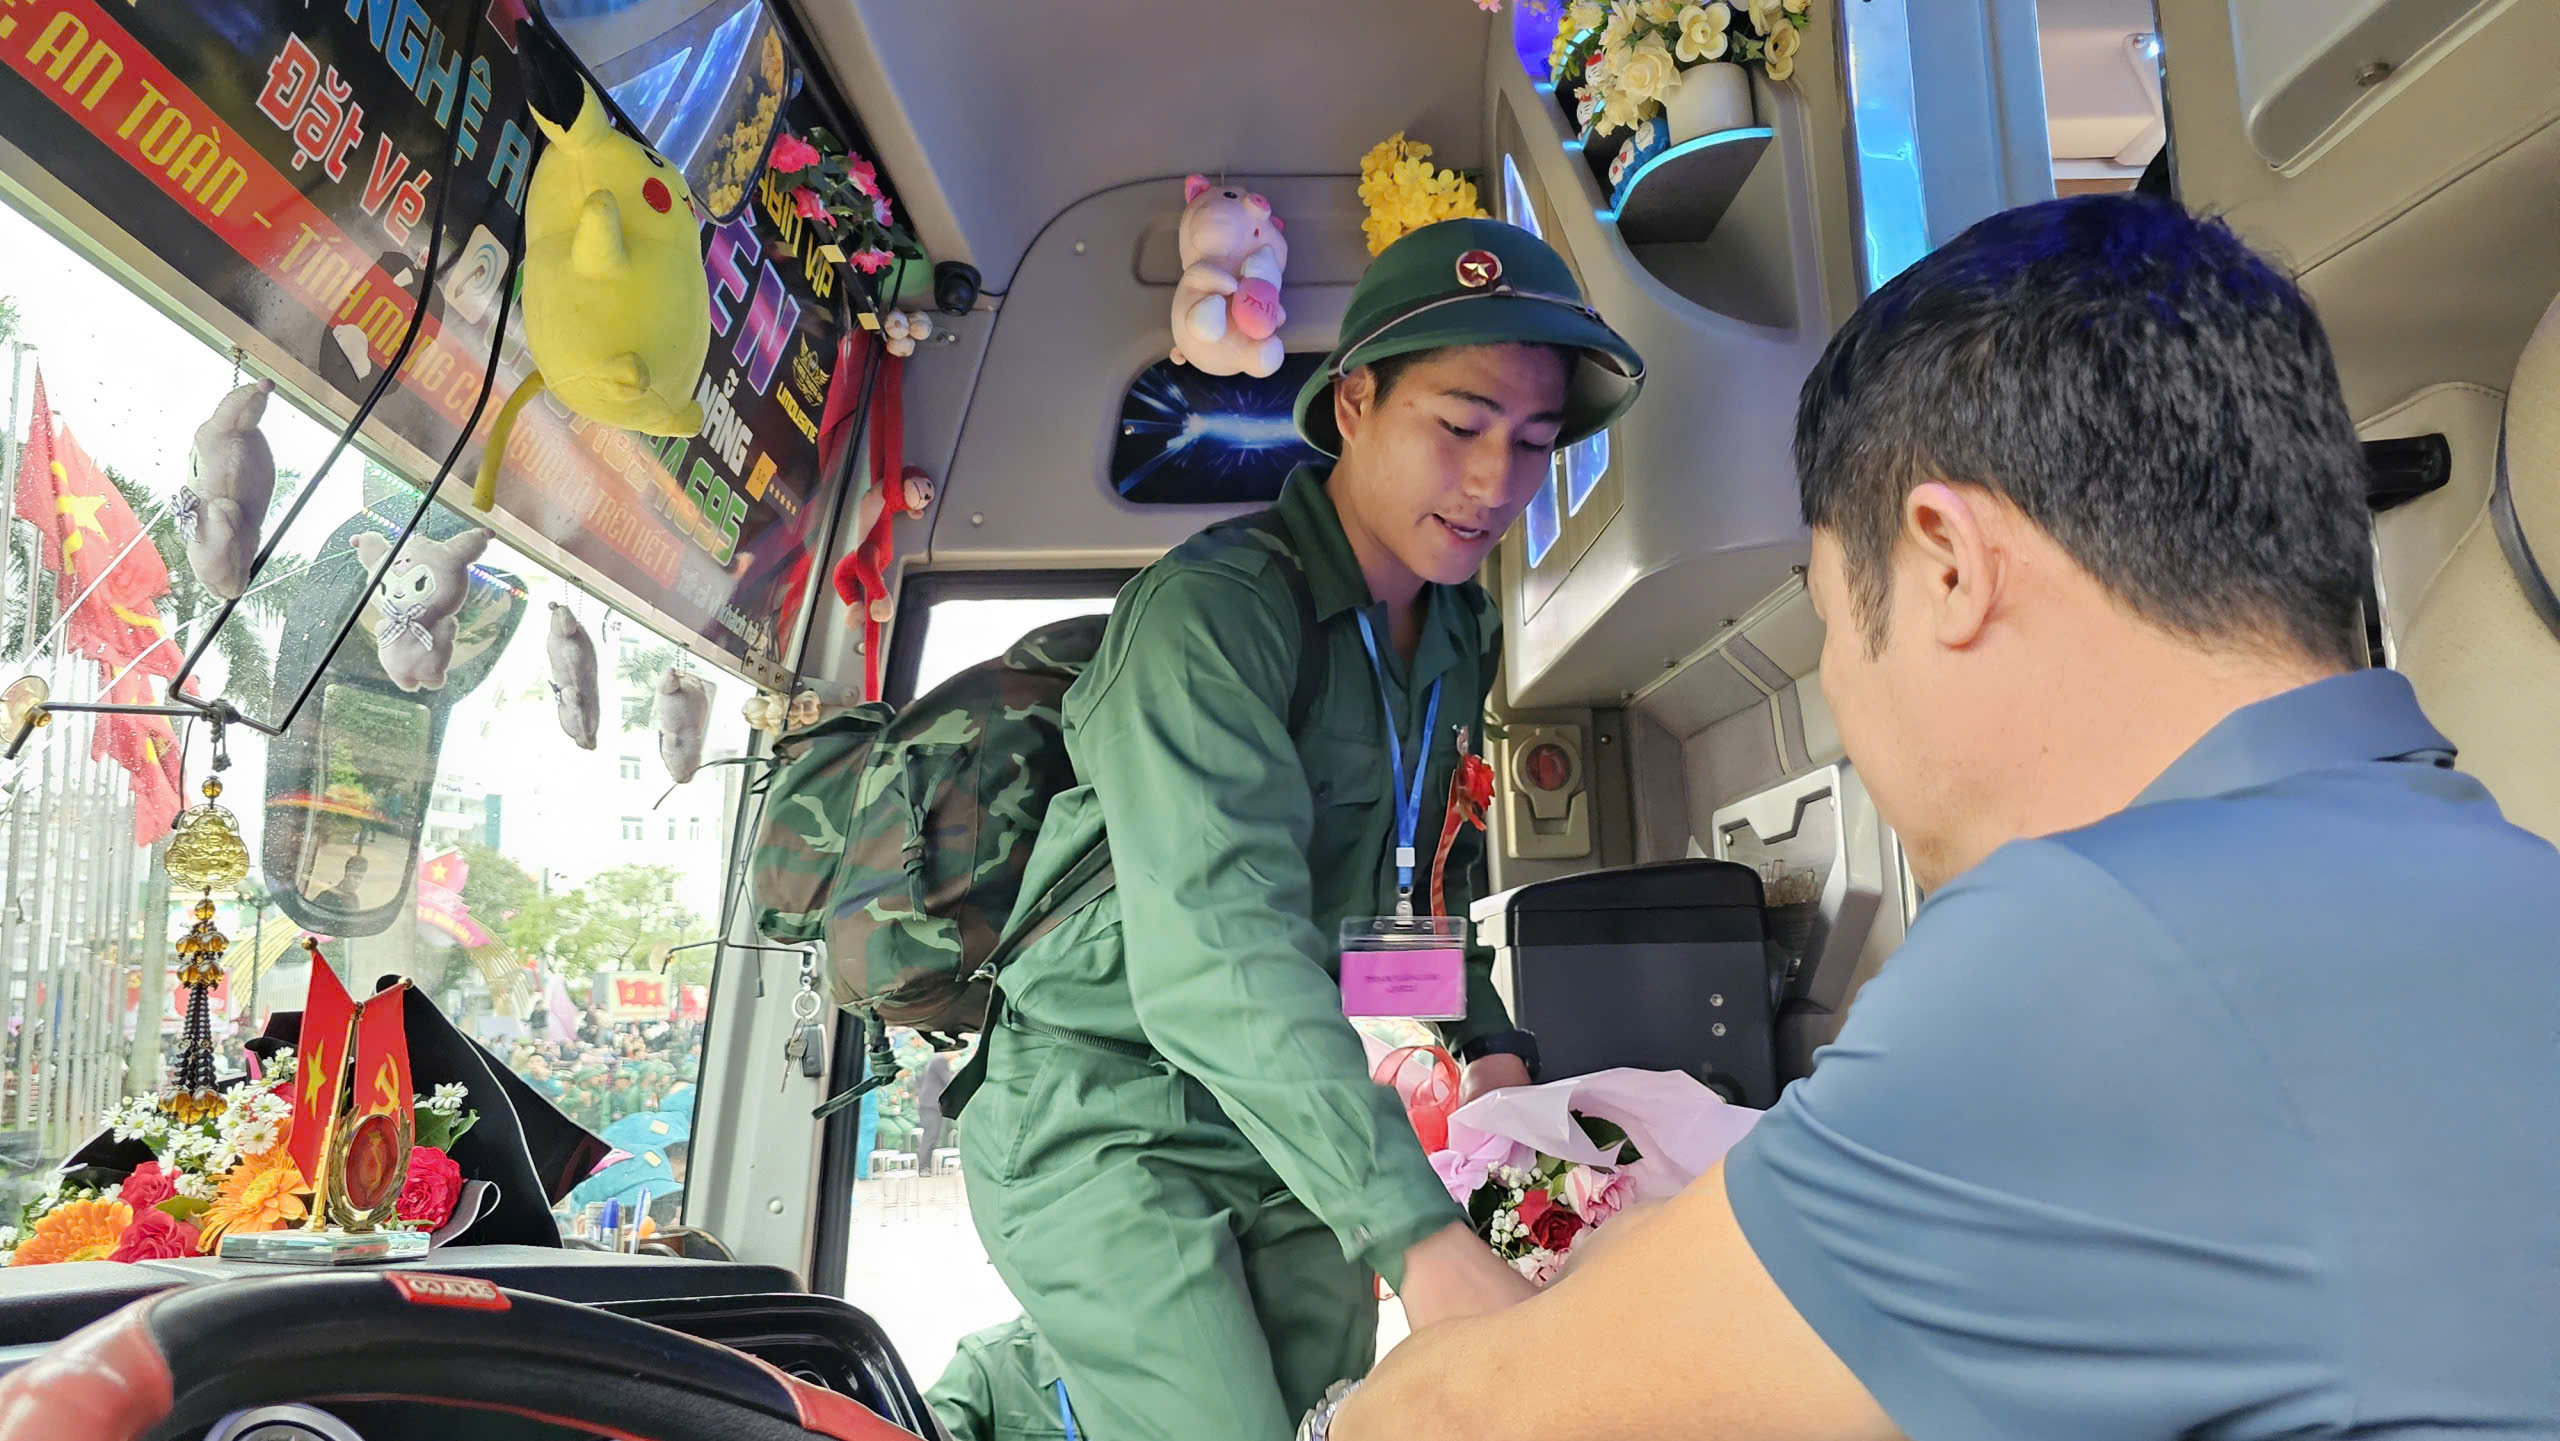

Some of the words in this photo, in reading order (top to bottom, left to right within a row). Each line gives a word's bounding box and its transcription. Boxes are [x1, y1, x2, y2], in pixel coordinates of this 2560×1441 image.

[25, 11, 124, 112] AN
[117, 78, 249, 217] TOÀN
[279, 222, 372, 321] TÍNH
[256, 32, 364, 184] Đặt
[697, 367, 754, 477] NẴNG
